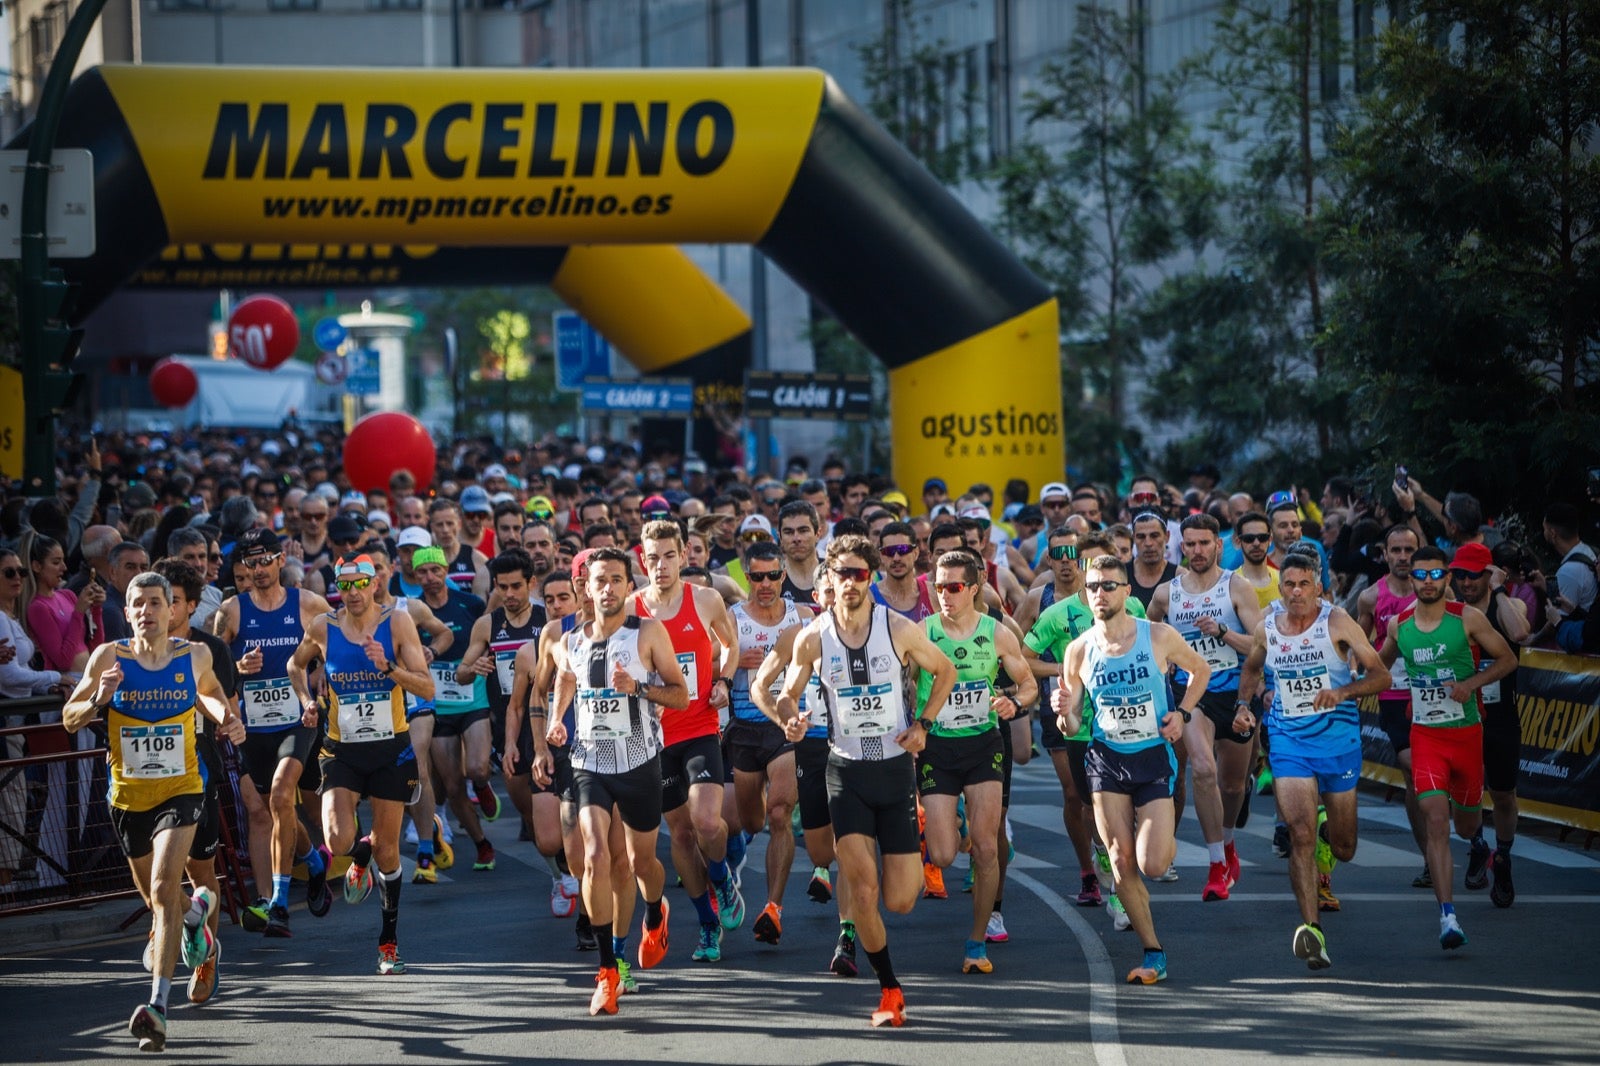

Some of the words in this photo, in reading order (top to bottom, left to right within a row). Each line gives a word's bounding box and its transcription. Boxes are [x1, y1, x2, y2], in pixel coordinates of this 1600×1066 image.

[201, 100, 735, 181] MARCELINO
[262, 186, 673, 225] www.mpmarcelino.es
[605, 387, 655, 408] CAJÓN
[659, 390, 671, 408] 2
[773, 383, 830, 408] CAJÓN
[834, 387, 845, 408] 1
[921, 405, 1058, 446] agustinos
[945, 444, 1046, 458] GRANADA
[245, 637, 299, 648] TROTASIERRA
[1274, 651, 1325, 665] MARACENA
[330, 670, 390, 686] agustino
[1095, 664, 1150, 687] nerja
[1286, 676, 1323, 694] 1433
[121, 687, 188, 705] agustinos
[252, 687, 290, 703] 2005
[948, 690, 983, 706] 1917
[1420, 687, 1446, 701] 275
[355, 703, 375, 717] 12
[585, 699, 621, 714] 1382
[851, 696, 883, 712] 392
[1109, 705, 1147, 720] 1293
[131, 737, 175, 752] 1108
